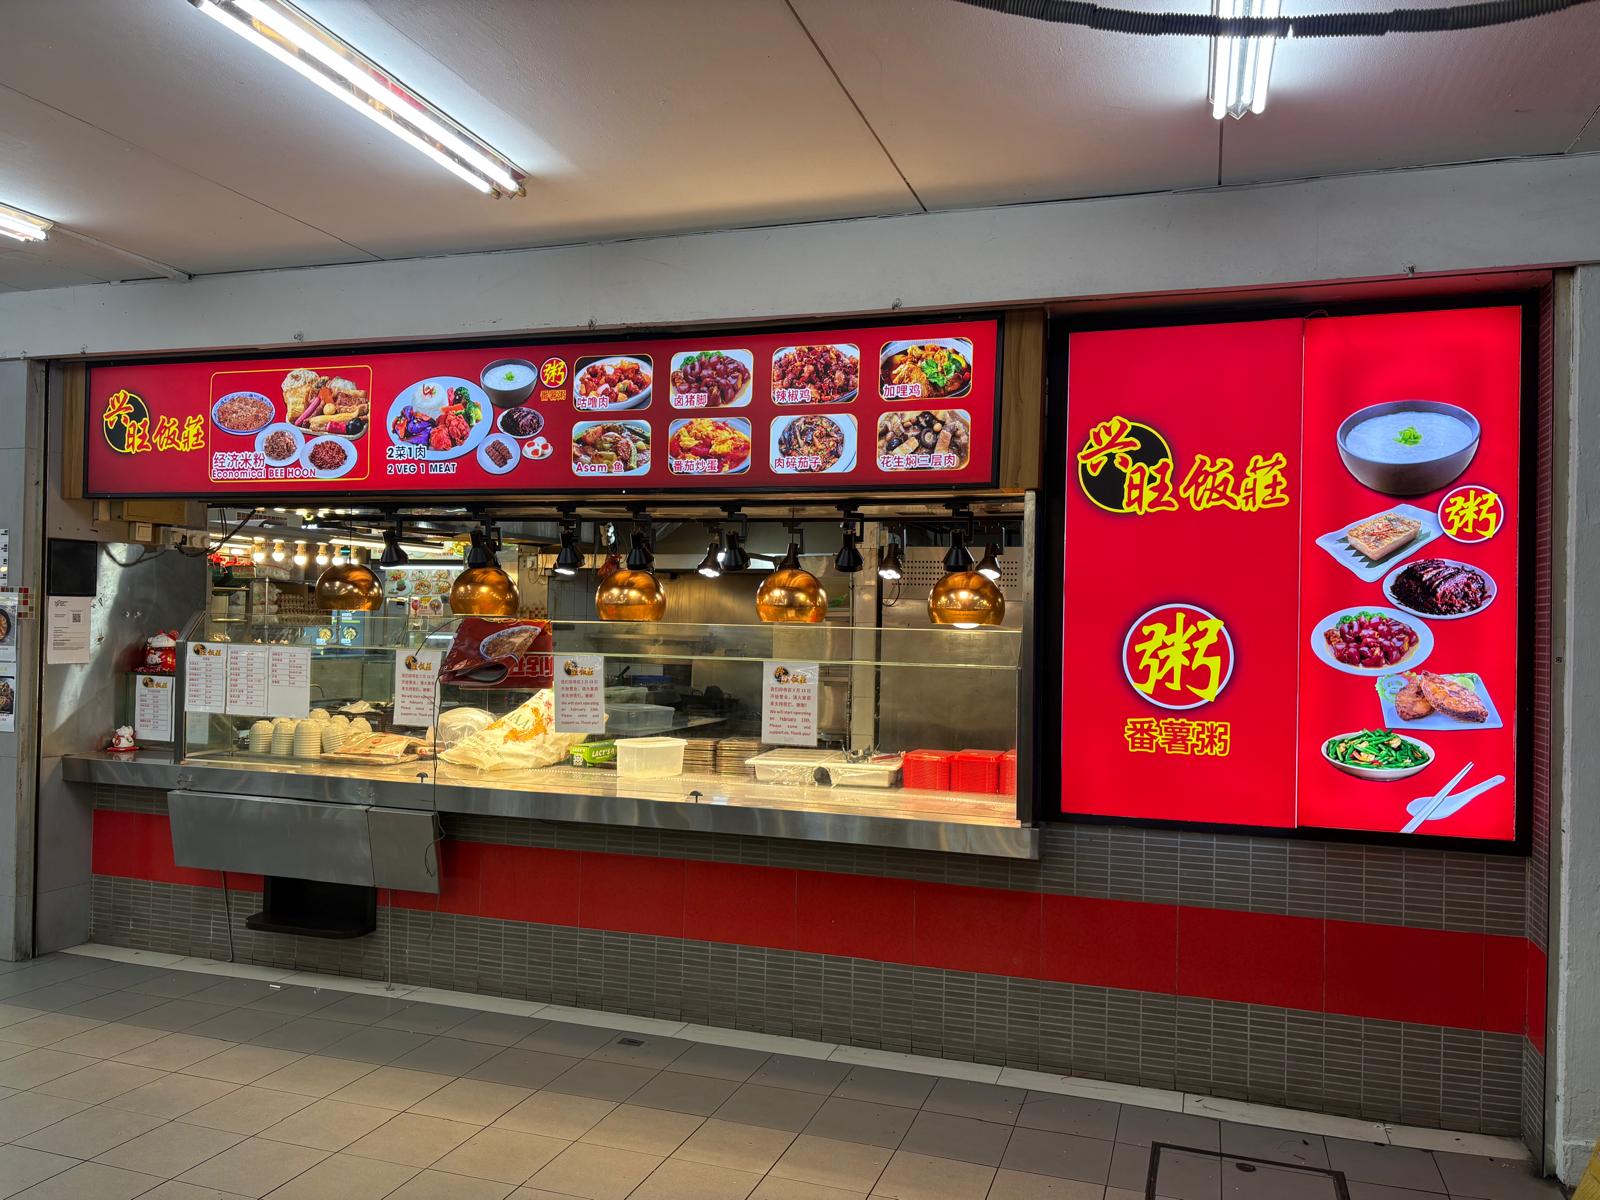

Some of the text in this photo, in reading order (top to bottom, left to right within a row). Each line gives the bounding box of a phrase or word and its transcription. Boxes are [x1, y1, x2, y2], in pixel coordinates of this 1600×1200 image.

[543, 360, 566, 385] 粥
[775, 388, 811, 403] 辣椒鸡
[883, 383, 921, 398] 加哩鸡
[386, 444, 427, 460] 2菜1肉
[212, 452, 265, 469] 经济米粉
[387, 462, 457, 474] 2 VEG 1 MEAT
[575, 460, 624, 473] Asam 鱼
[673, 459, 719, 473] 番茄炒蛋
[774, 456, 821, 470] 肉碎茄子
[880, 454, 956, 469] 花生焖三层肉
[212, 467, 317, 479] Economical BEE HOON
[1445, 491, 1499, 538] 粥
[1132, 612, 1225, 703] 粥
[1124, 716, 1232, 757] 番薯粥
